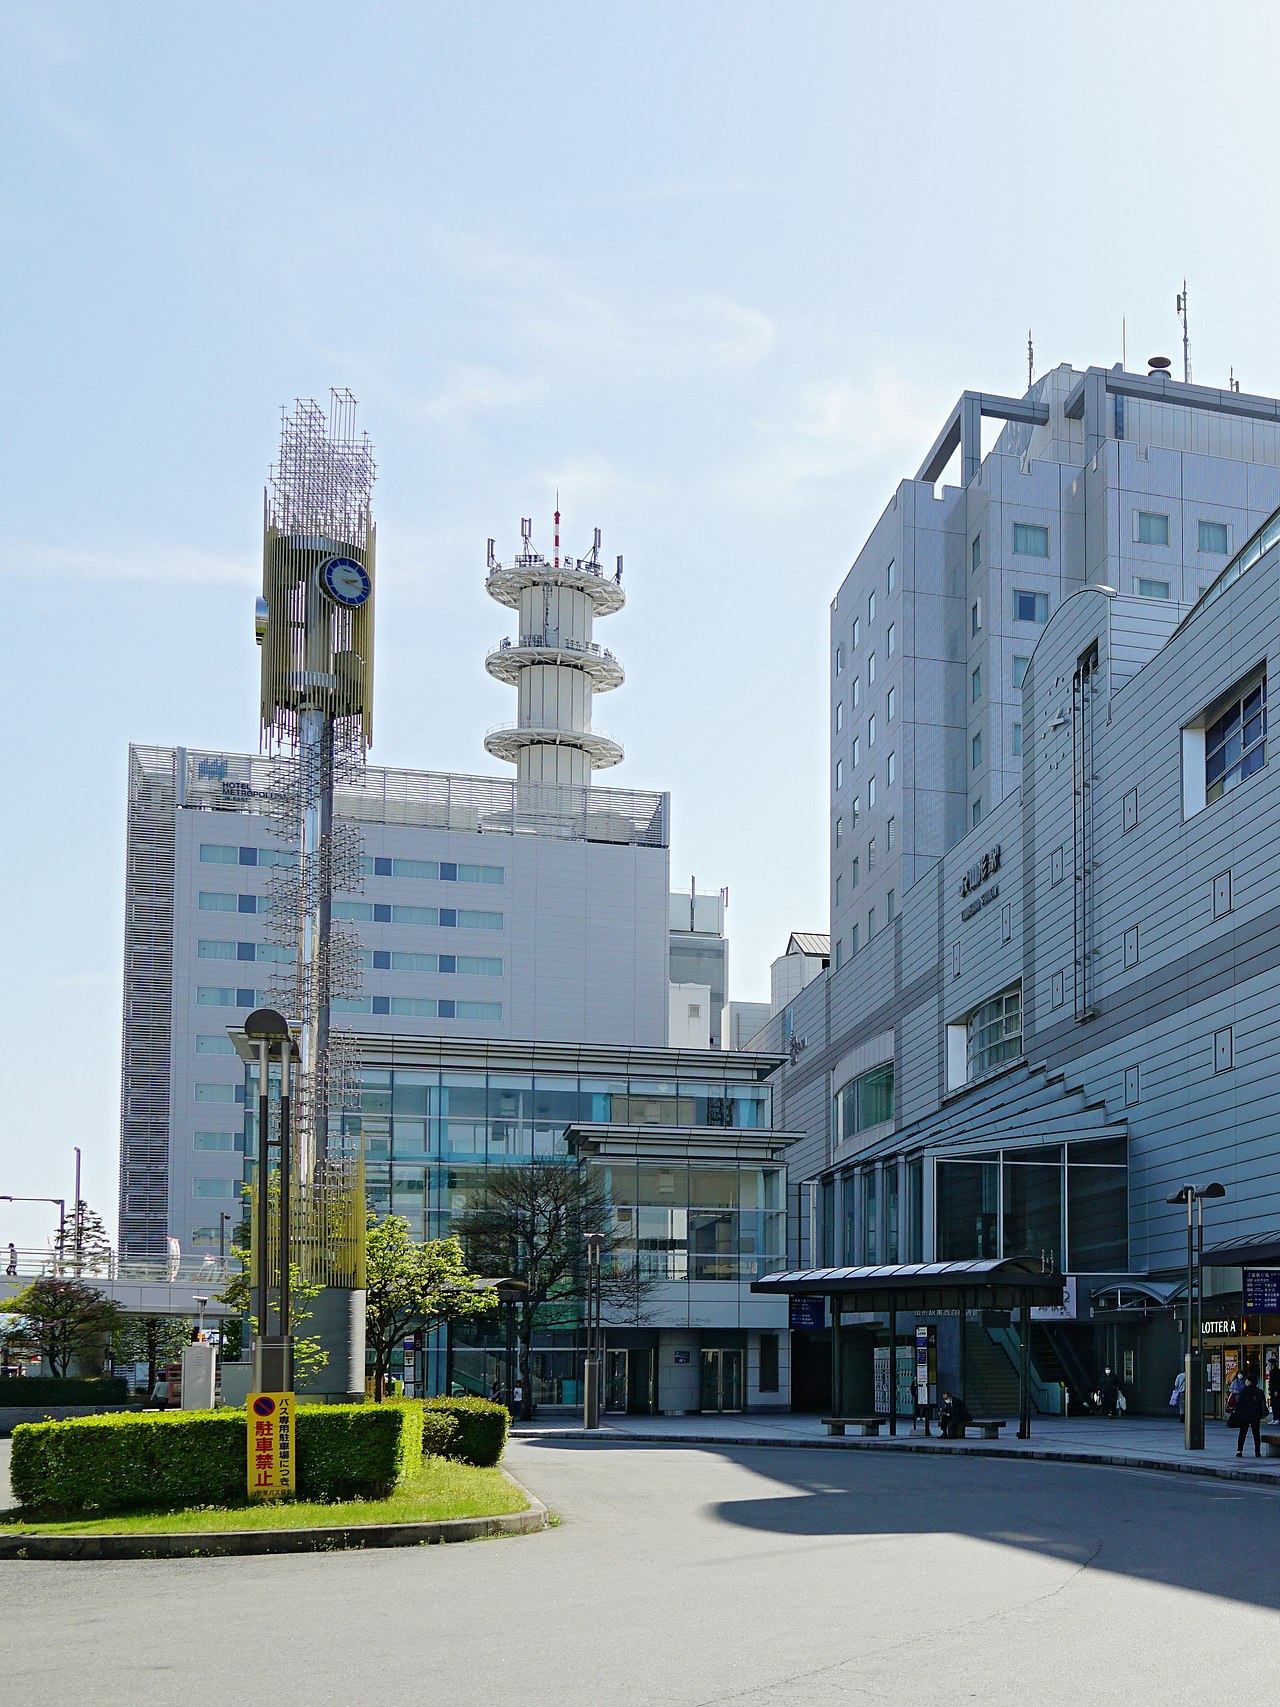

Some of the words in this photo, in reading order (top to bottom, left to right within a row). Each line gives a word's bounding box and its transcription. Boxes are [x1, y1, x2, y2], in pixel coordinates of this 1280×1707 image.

[222, 782, 250, 791] HOTEL
[929, 1334, 936, 1344] 4
[415, 1340, 422, 1348] 5
[254, 1420, 274, 1487] 駐車禁止
